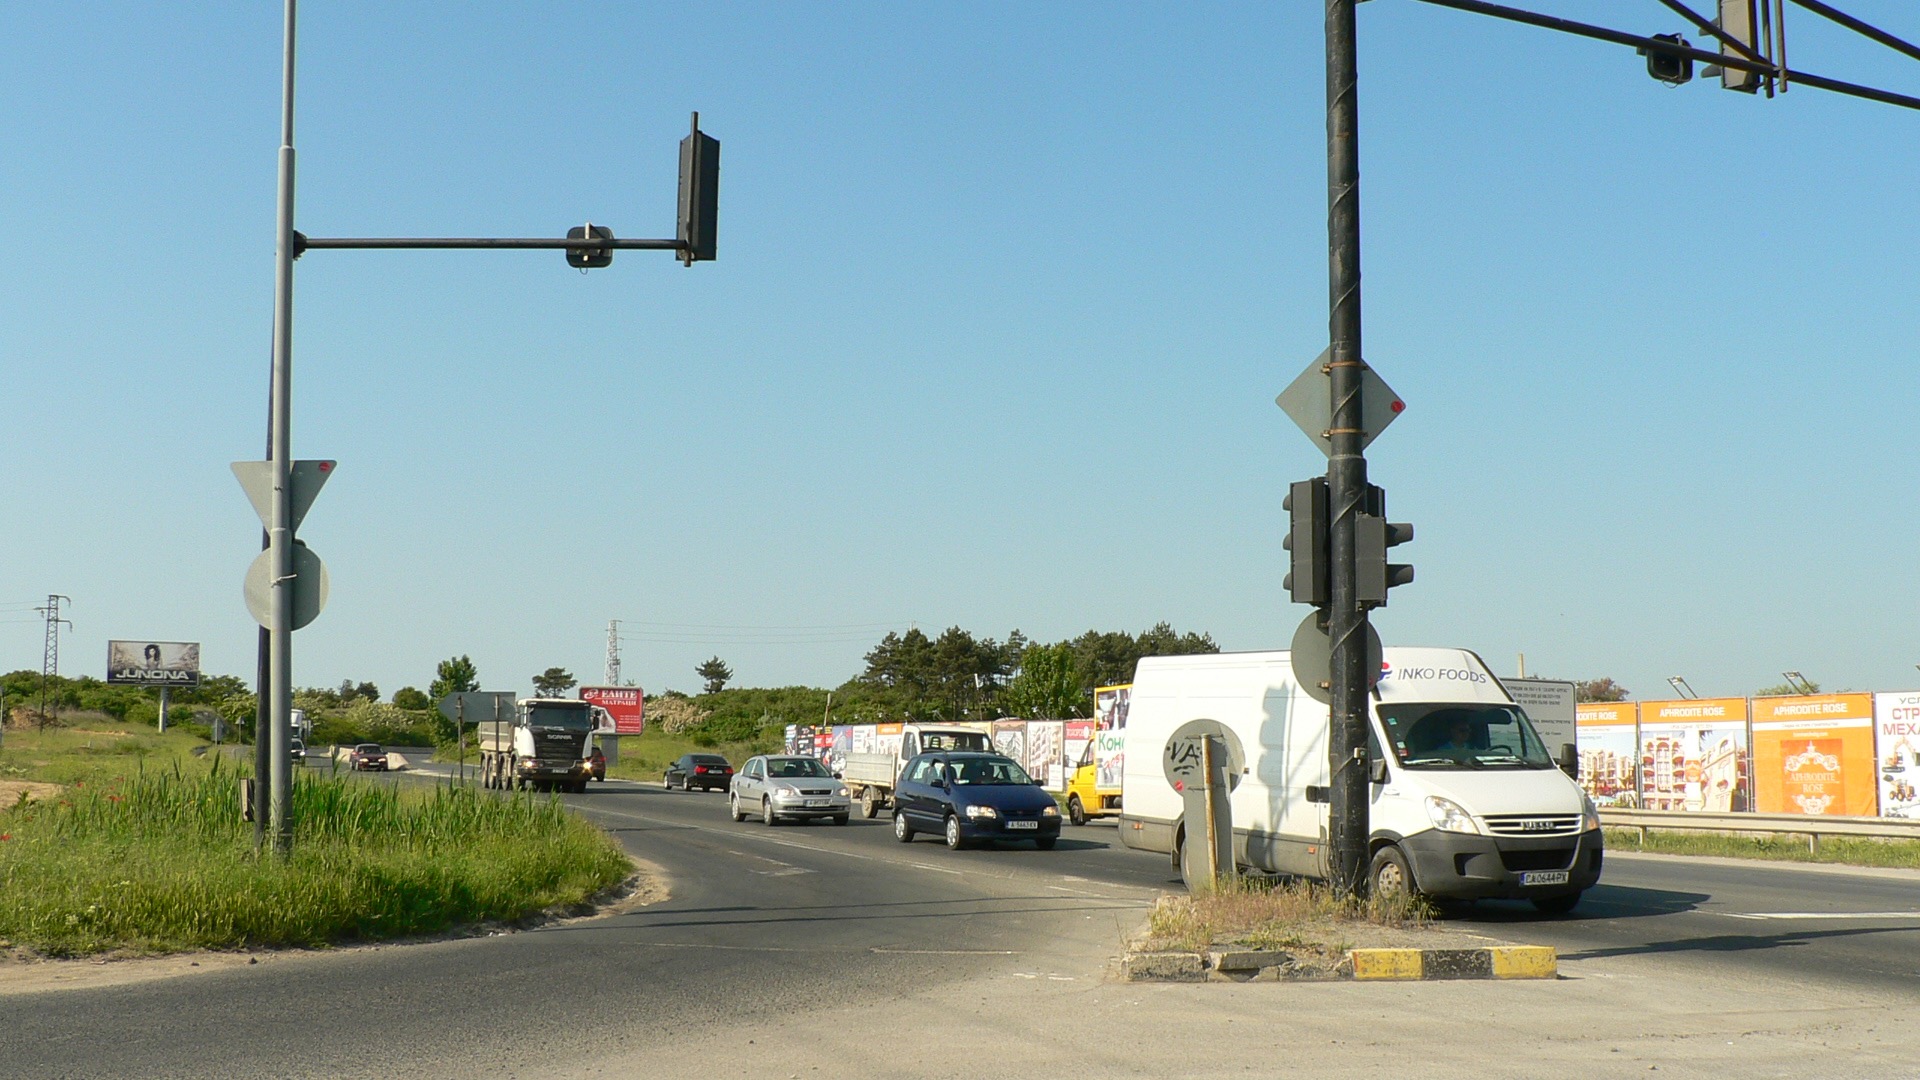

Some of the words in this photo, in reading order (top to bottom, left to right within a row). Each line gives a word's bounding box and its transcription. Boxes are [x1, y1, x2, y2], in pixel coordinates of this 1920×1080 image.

[115, 667, 189, 679] JUNONA
[1398, 668, 1435, 680] INKO
[1438, 668, 1487, 684] FOODS
[1659, 707, 1702, 718] APHRODITE
[1702, 706, 1726, 716] ROSE
[1773, 704, 1822, 715] APHRODITE
[1822, 703, 1848, 713] ROSE
[1598, 711, 1619, 720] ROSE
[1790, 772, 1836, 782] APHRODITE
[1802, 783, 1825, 793] ROSE
